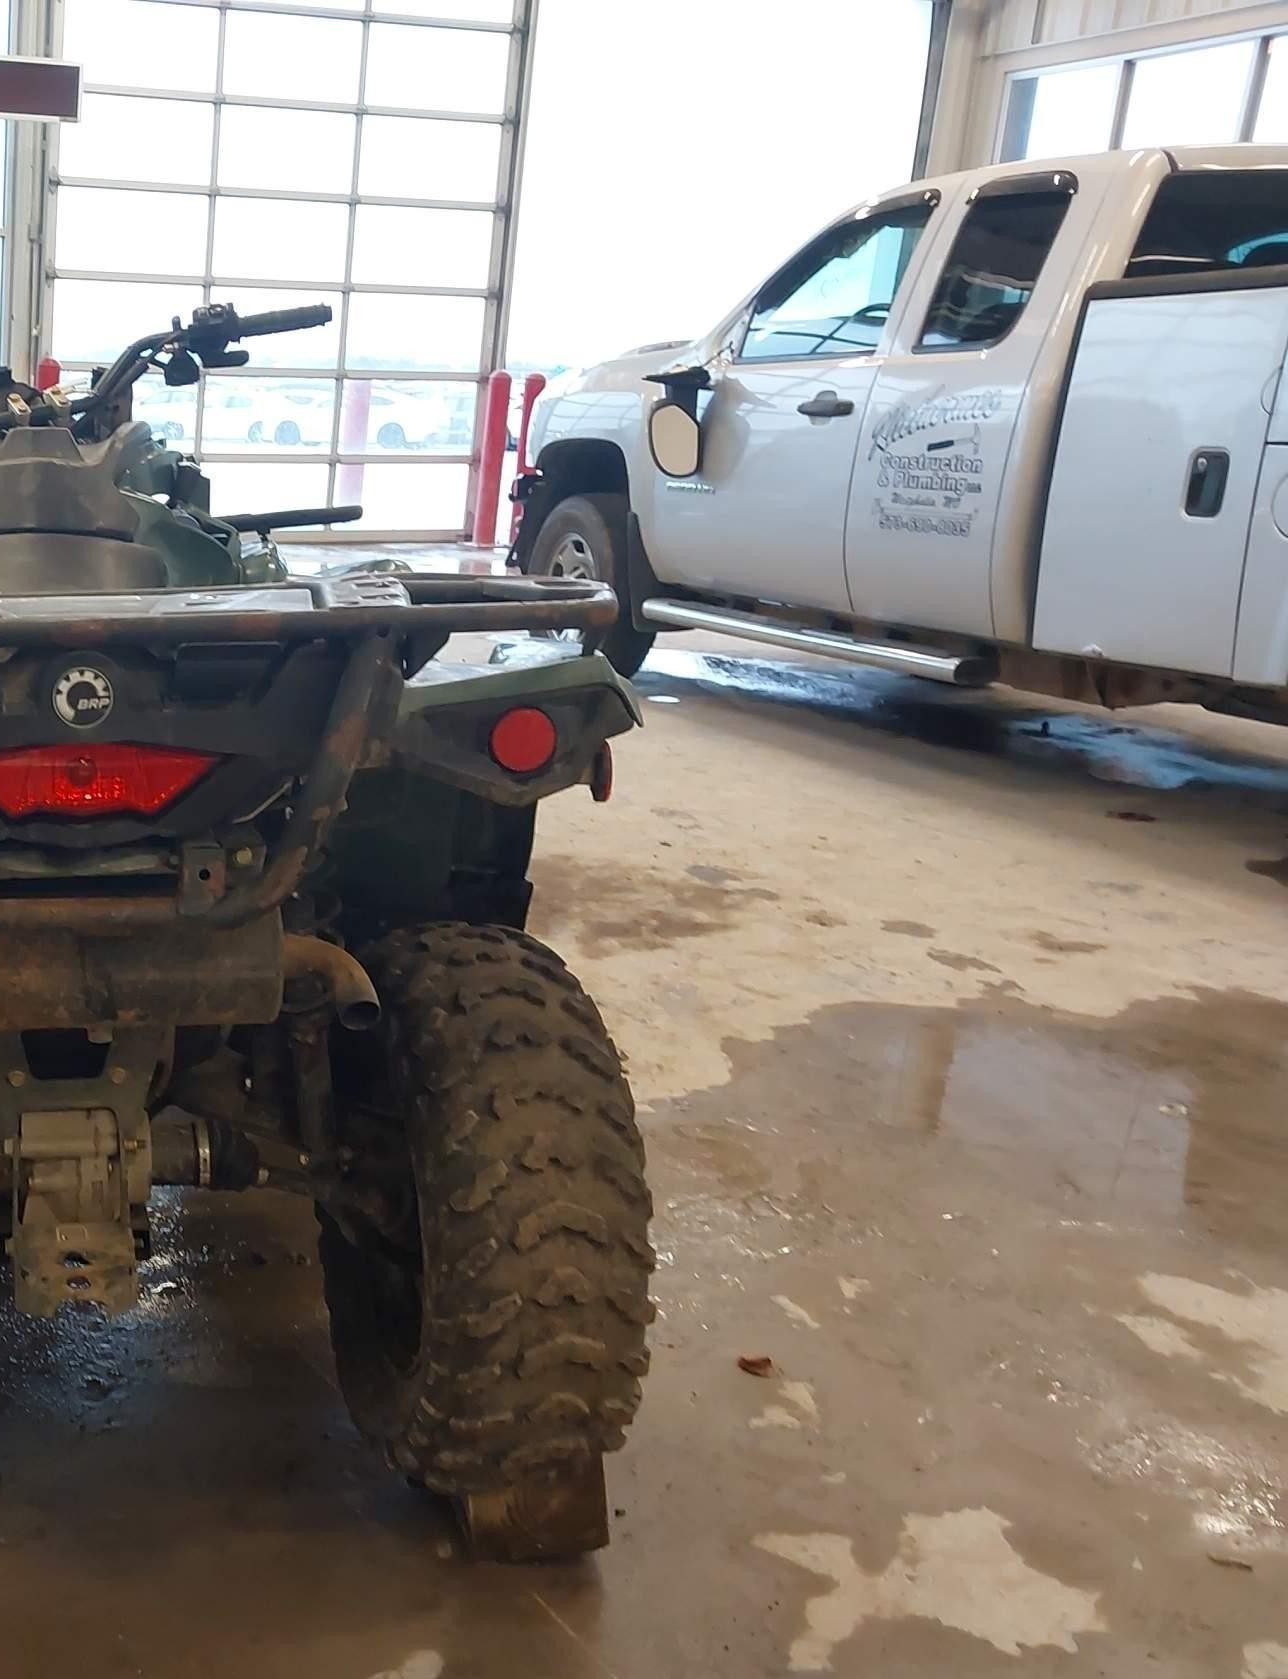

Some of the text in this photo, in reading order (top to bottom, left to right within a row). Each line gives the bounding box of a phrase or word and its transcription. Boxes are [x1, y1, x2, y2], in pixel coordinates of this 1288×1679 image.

[880, 453, 983, 474] Construction
[893, 470, 968, 496] Plumbing
[77, 698, 110, 710] BRP
